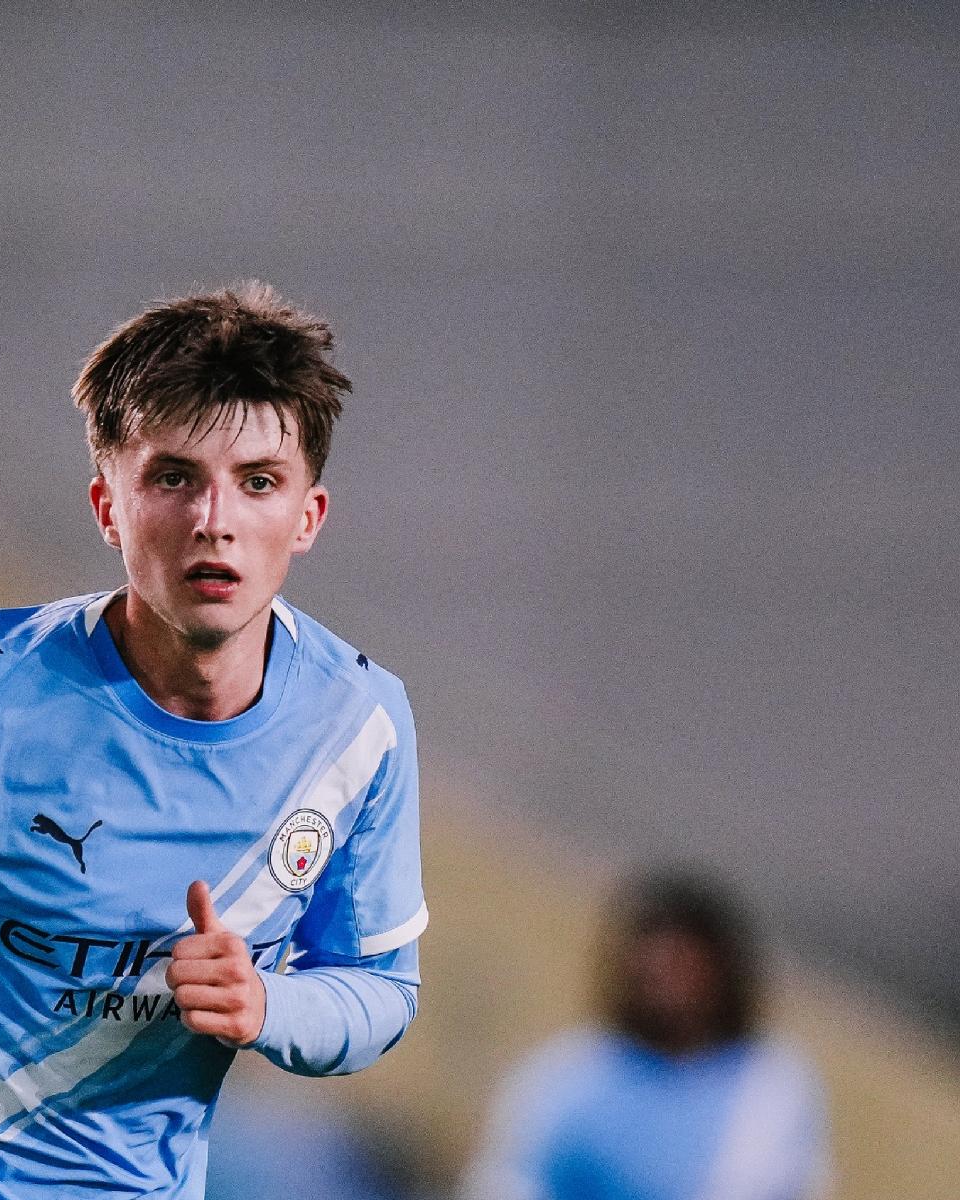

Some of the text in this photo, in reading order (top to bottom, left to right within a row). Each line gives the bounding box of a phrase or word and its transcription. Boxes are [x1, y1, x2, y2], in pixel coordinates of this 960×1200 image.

[279, 815, 329, 842] MANCHESTER
[290, 878, 308, 887] CITY
[53, 989, 182, 1022] AIRWA
